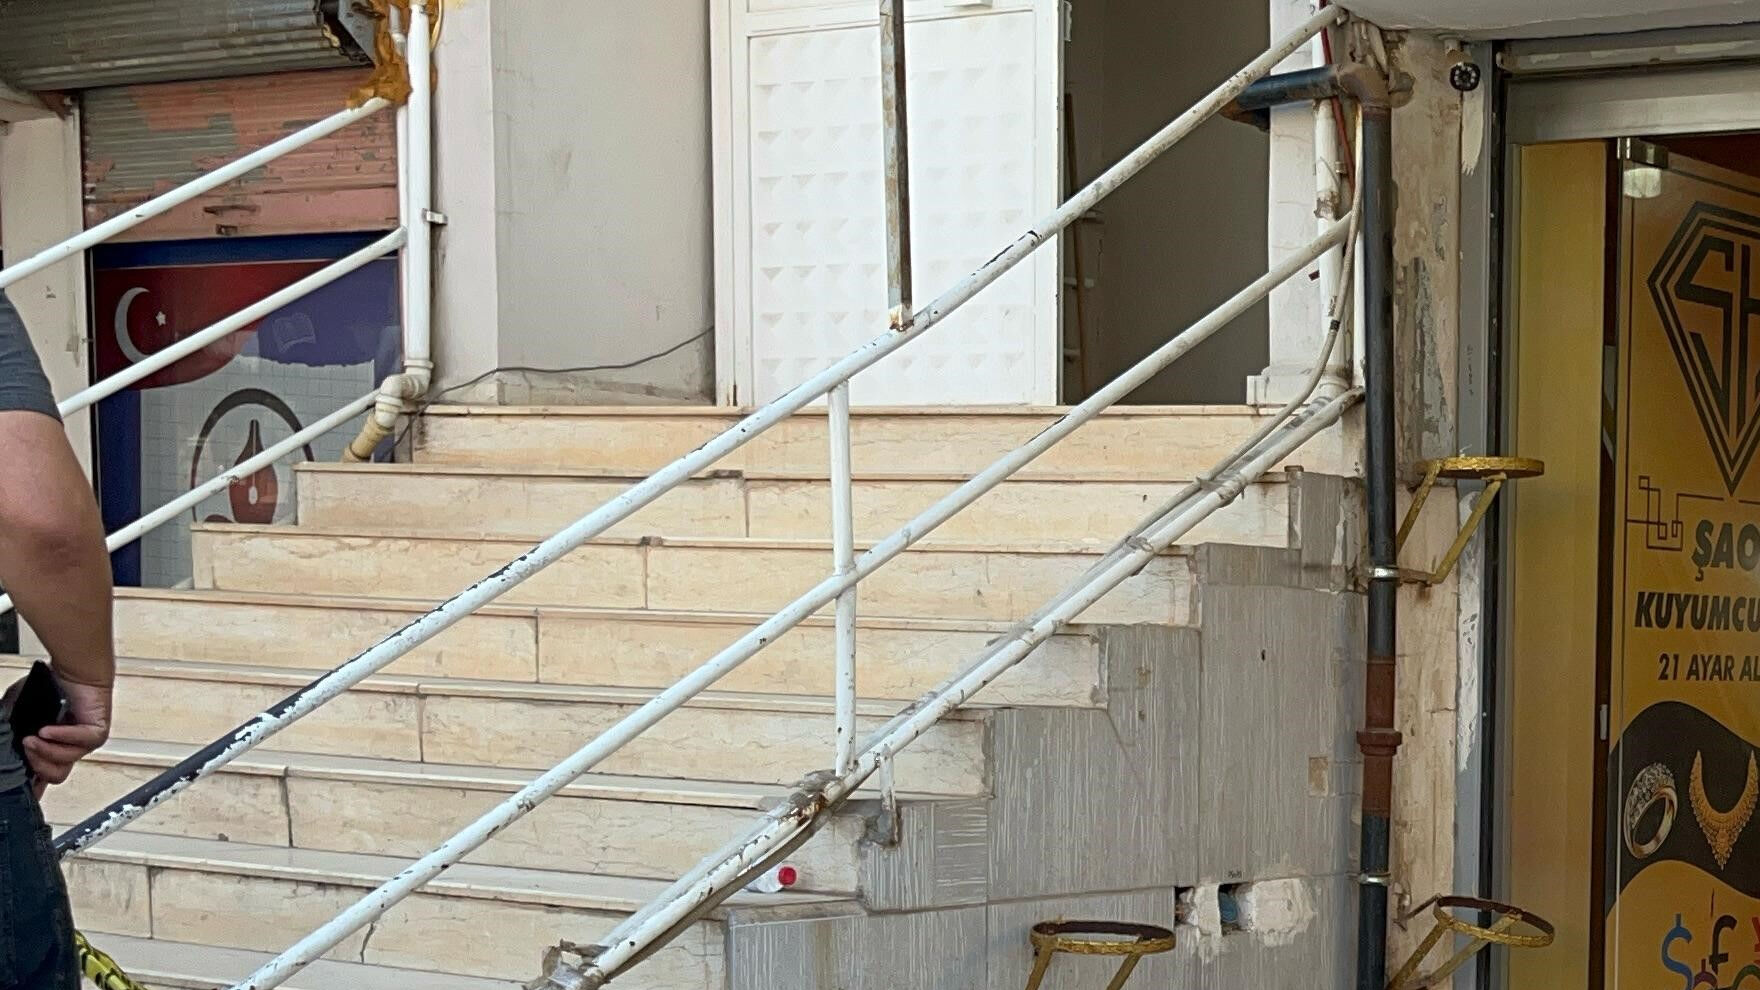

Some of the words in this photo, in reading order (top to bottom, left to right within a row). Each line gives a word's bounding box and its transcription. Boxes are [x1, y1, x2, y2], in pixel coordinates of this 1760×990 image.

[1692, 520, 1760, 582] ŞAO
[1658, 653, 1679, 681] 21
[1686, 654, 1735, 682] AYAR
